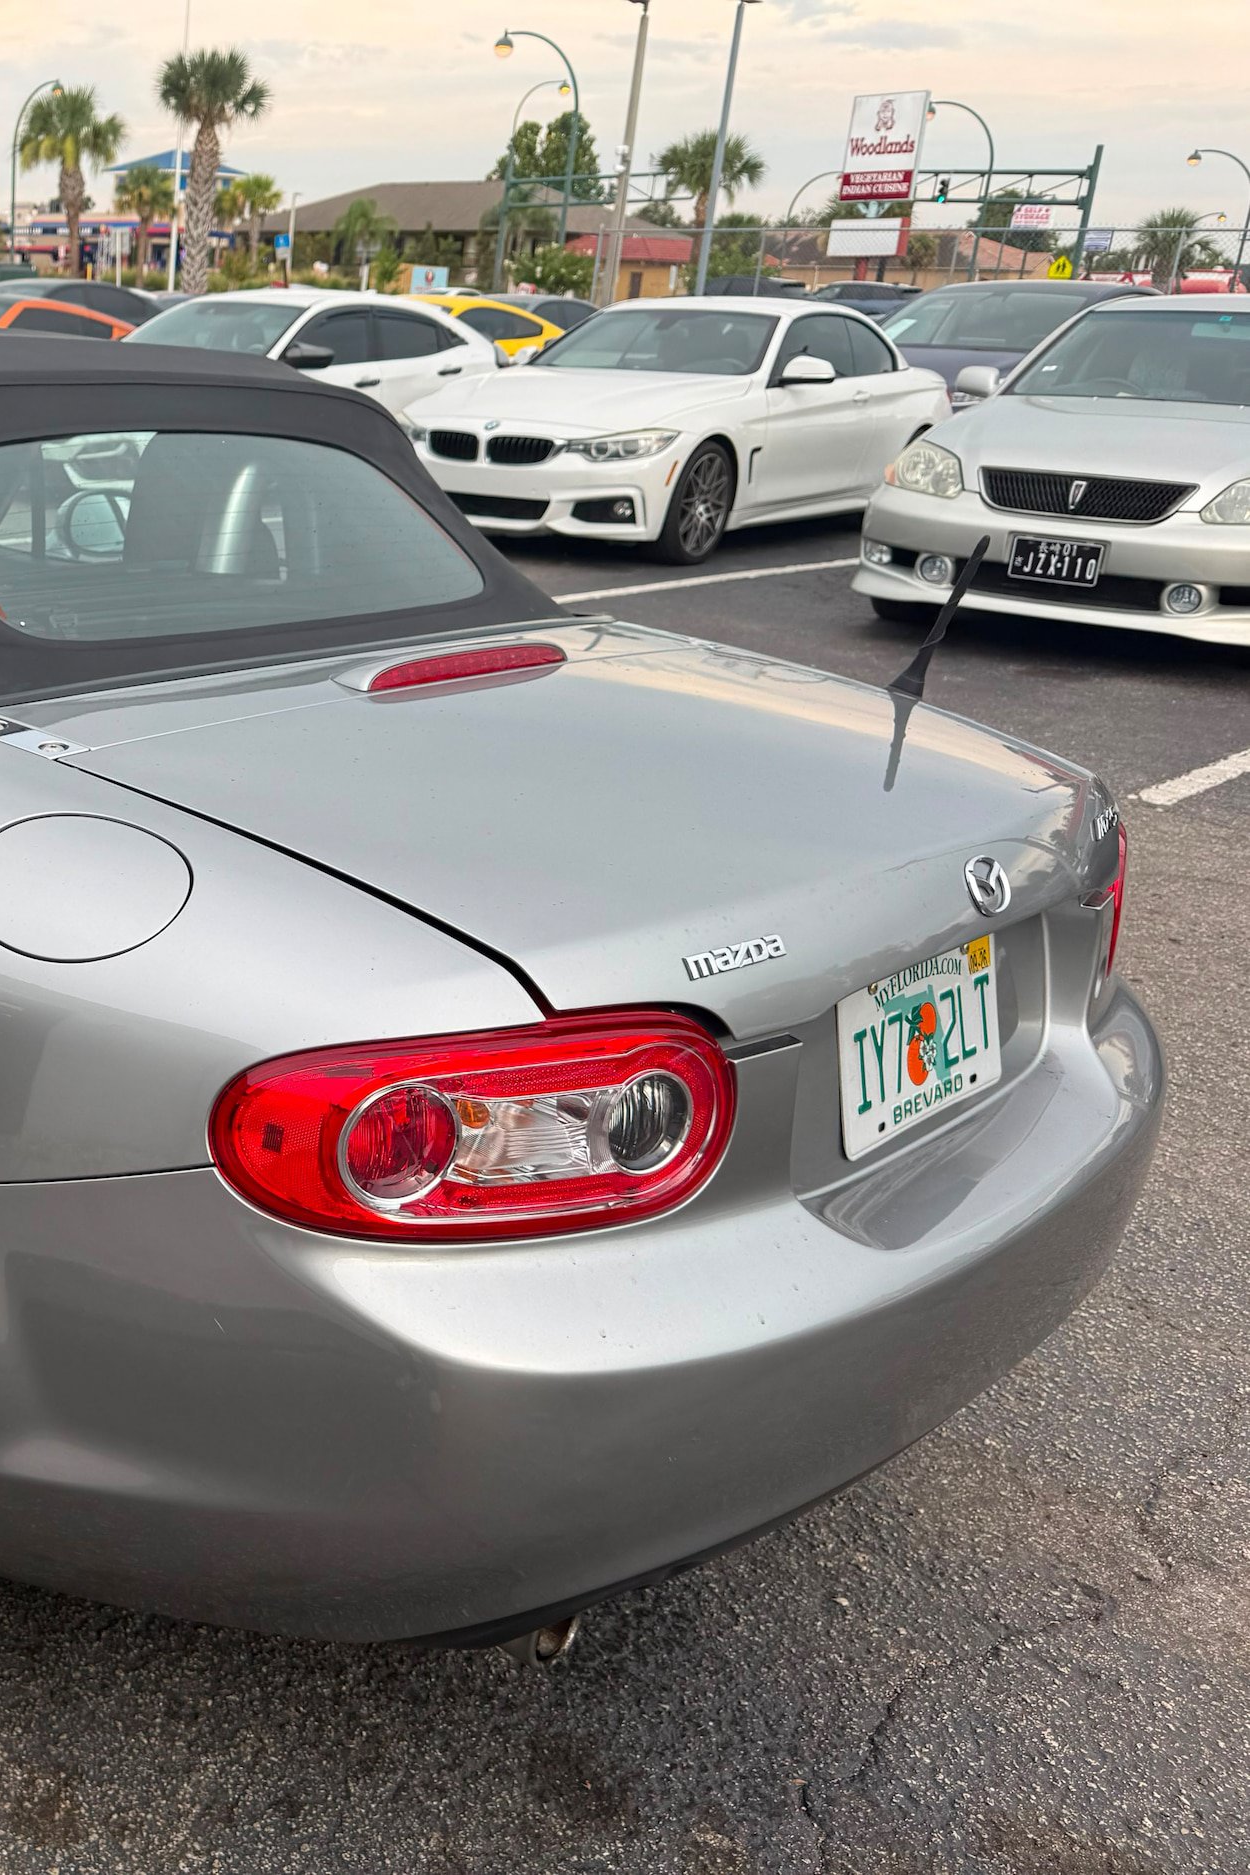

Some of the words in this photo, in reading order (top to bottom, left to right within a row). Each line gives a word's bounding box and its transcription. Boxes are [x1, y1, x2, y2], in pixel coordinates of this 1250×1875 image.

[850, 134, 915, 158] Woodlands
[849, 171, 906, 183] VEGETARIAN
[842, 184, 871, 195] INDIAN
[872, 182, 910, 194] CUISINE
[1024, 206, 1043, 214] SELF
[873, 956, 962, 1012] MYFLORIDA.COM
[893, 1072, 963, 1125] BREVARD
